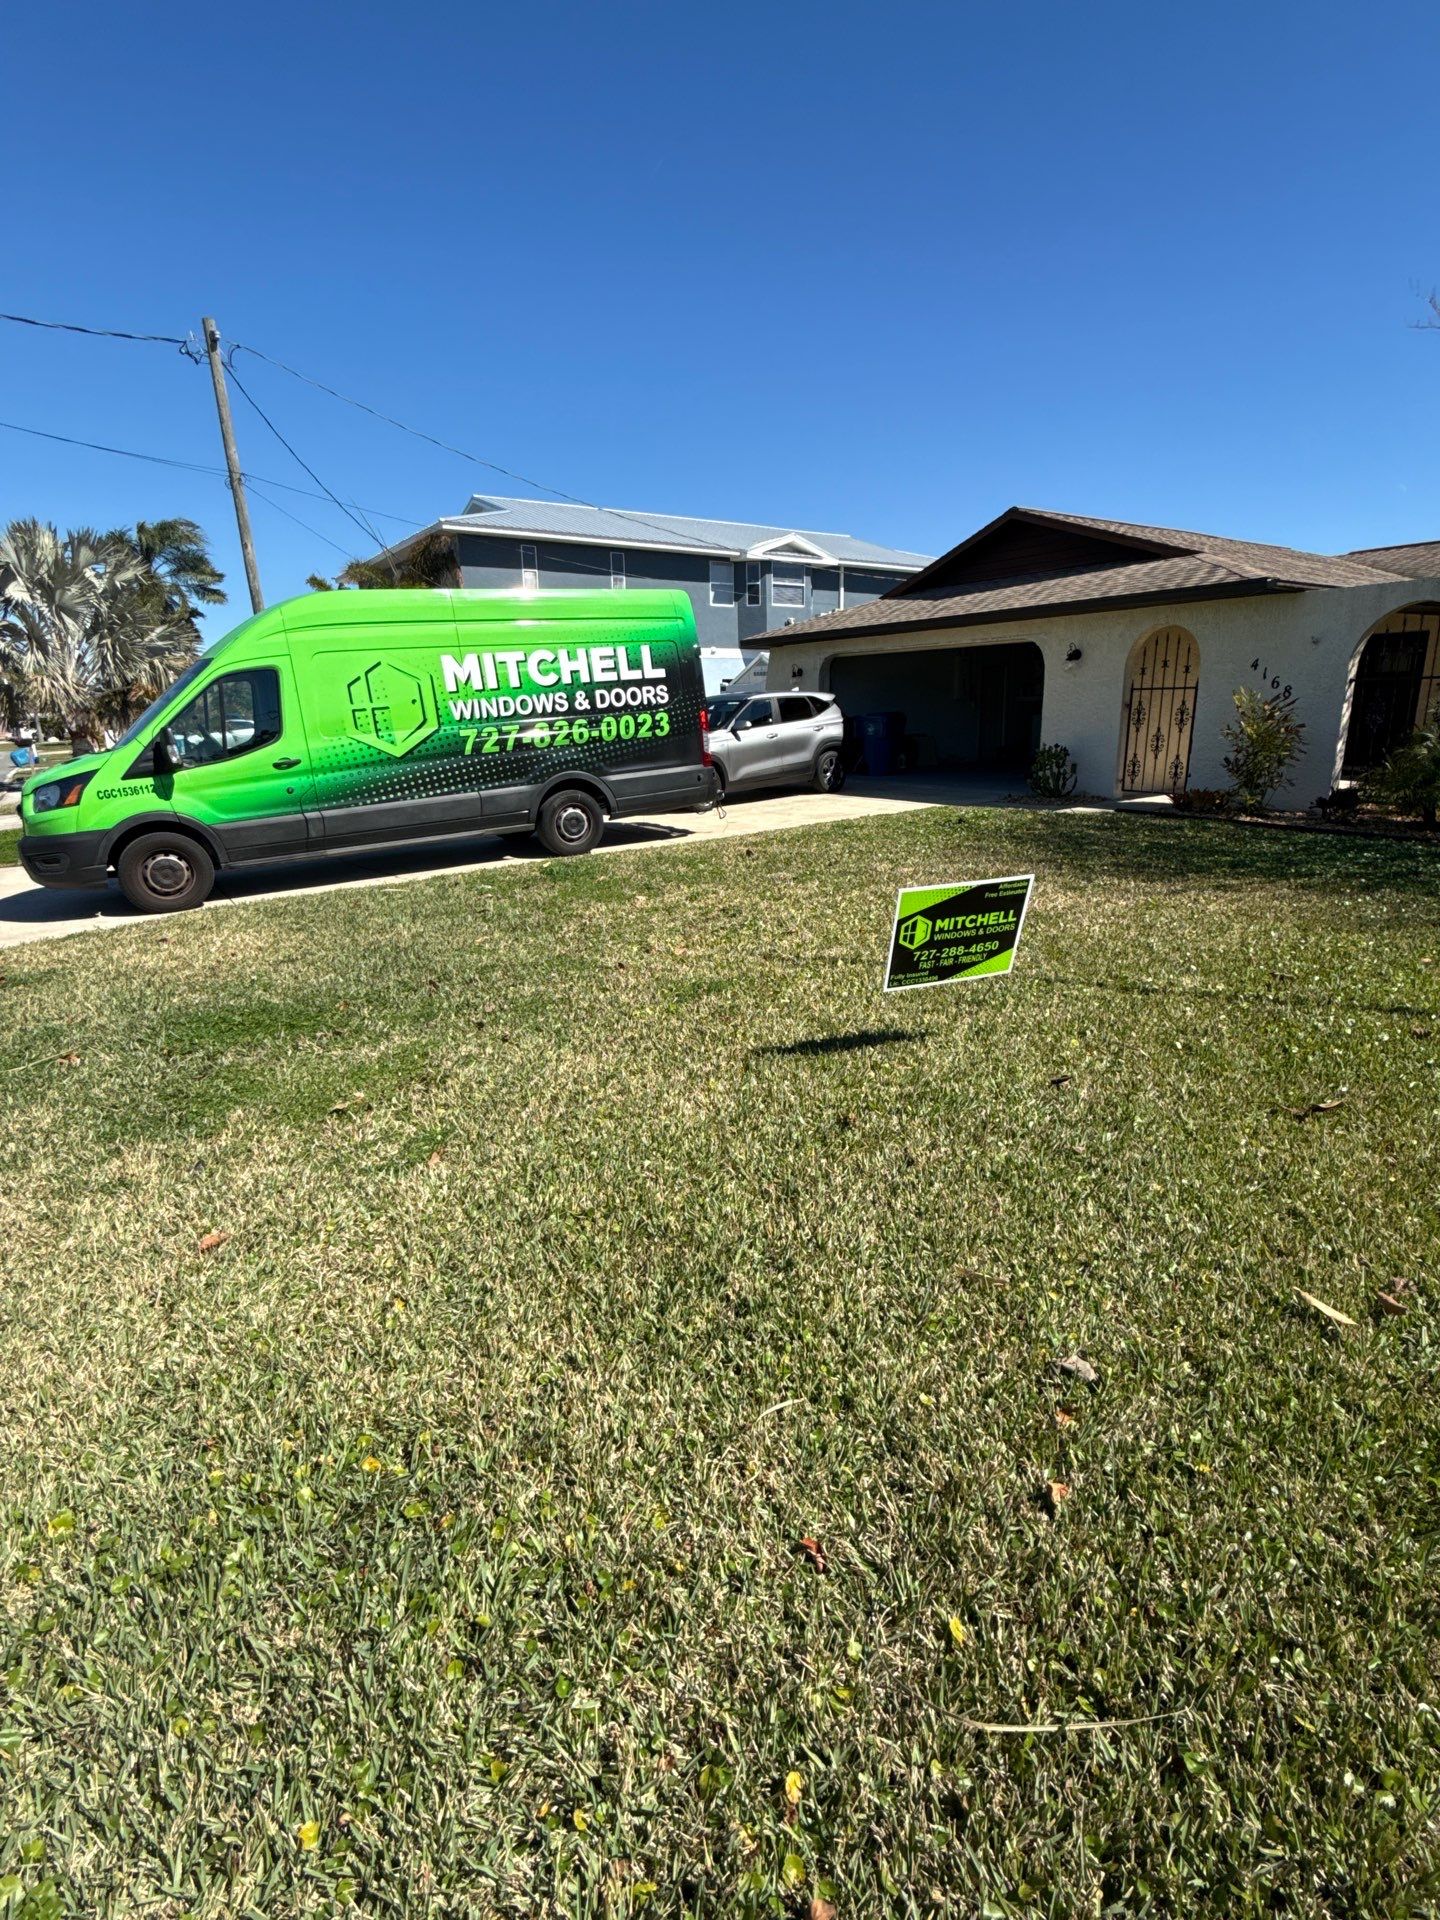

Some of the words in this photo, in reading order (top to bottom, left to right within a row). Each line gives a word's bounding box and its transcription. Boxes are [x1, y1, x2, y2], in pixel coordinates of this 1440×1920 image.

[440, 645, 666, 692] MITCHELL
[1250, 657, 1293, 699] 4168
[448, 692, 568, 720] WINDOWS
[575, 691, 590, 710] &
[596, 685, 669, 707] DOORS
[459, 712, 670, 755] 727-826-0023
[97, 784, 157, 800] CGC1536112
[999, 888, 1027, 897] Estimates
[934, 929, 976, 941] WINDOWS
[978, 928, 984, 936] &
[986, 923, 1015, 934] DOORS
[935, 910, 1017, 932] MITCHELL
[913, 940, 999, 962] 727-288-4650
[919, 960, 935, 970] FAST
[939, 957, 954, 967] FAIR
[958, 953, 988, 965] FRIENDLY
